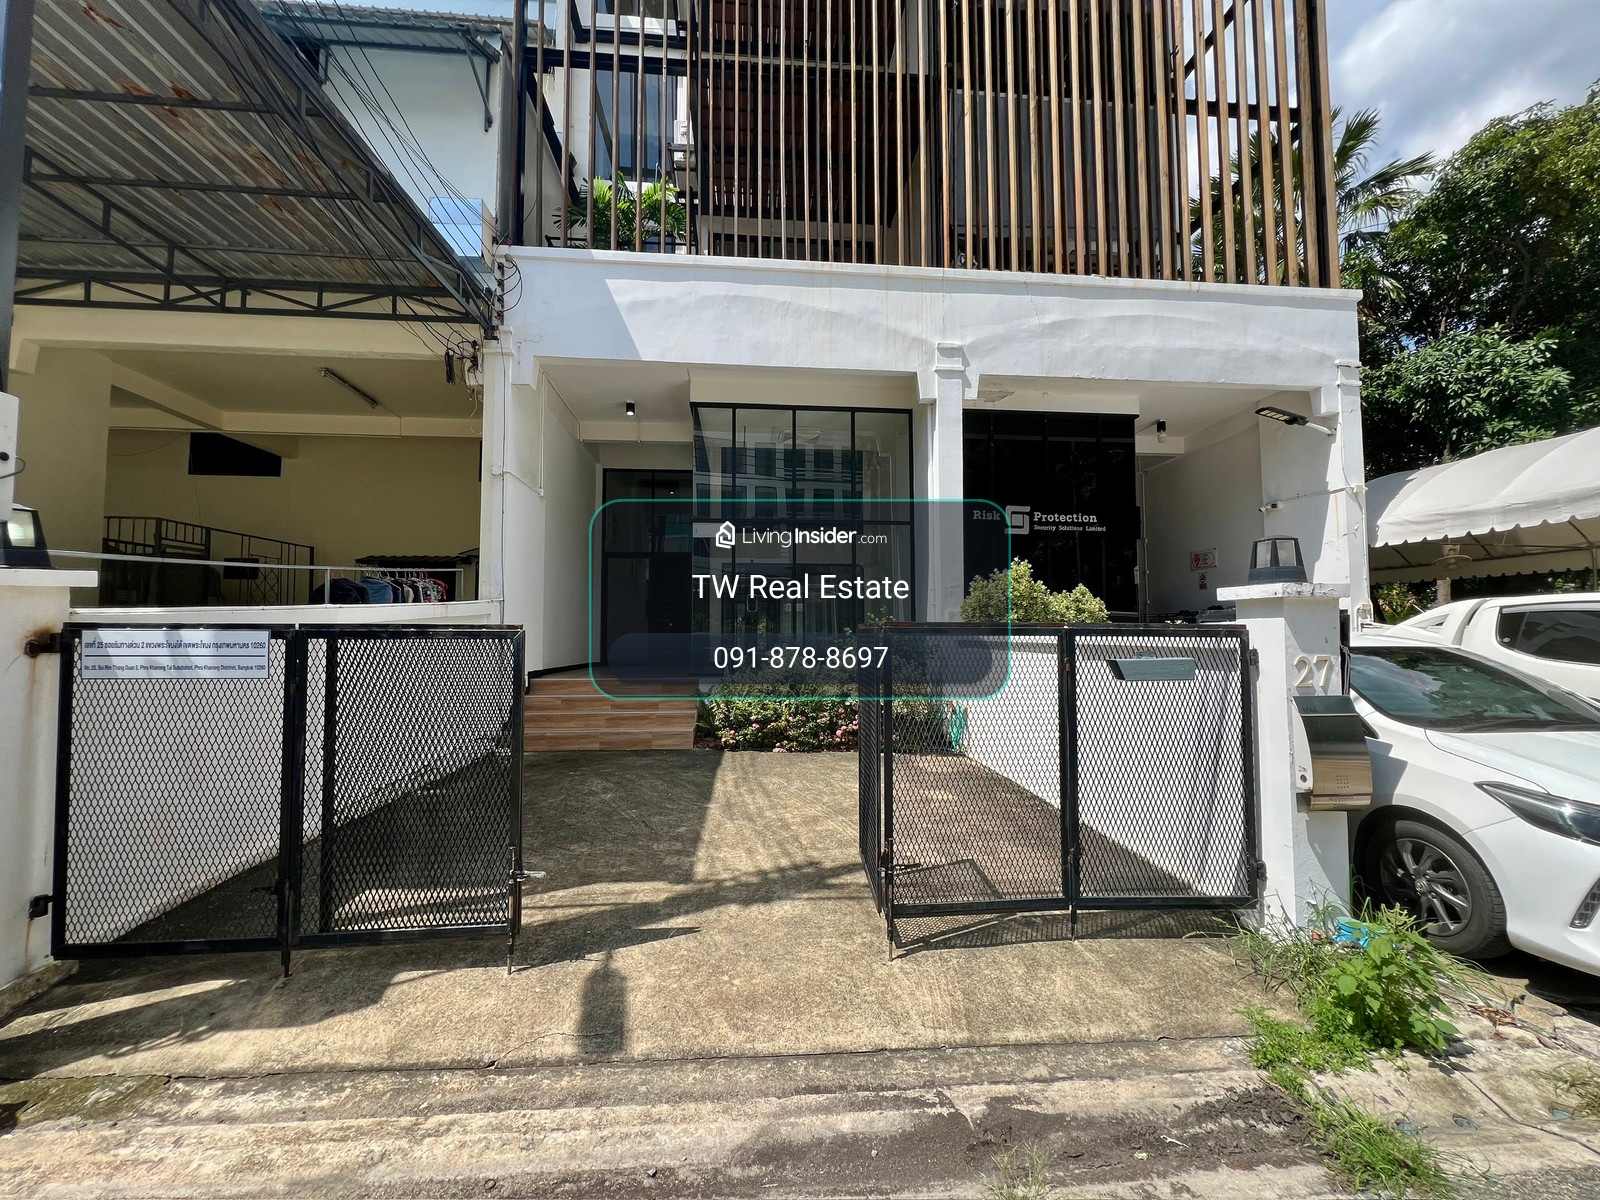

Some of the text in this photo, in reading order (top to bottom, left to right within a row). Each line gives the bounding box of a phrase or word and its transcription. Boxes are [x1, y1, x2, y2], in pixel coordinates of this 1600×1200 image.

[973, 510, 1098, 523] Risk Protection
[97, 641, 104, 649] 25
[141, 641, 145, 649] 2
[250, 641, 266, 649] 10260
[1294, 655, 1332, 688] 27
